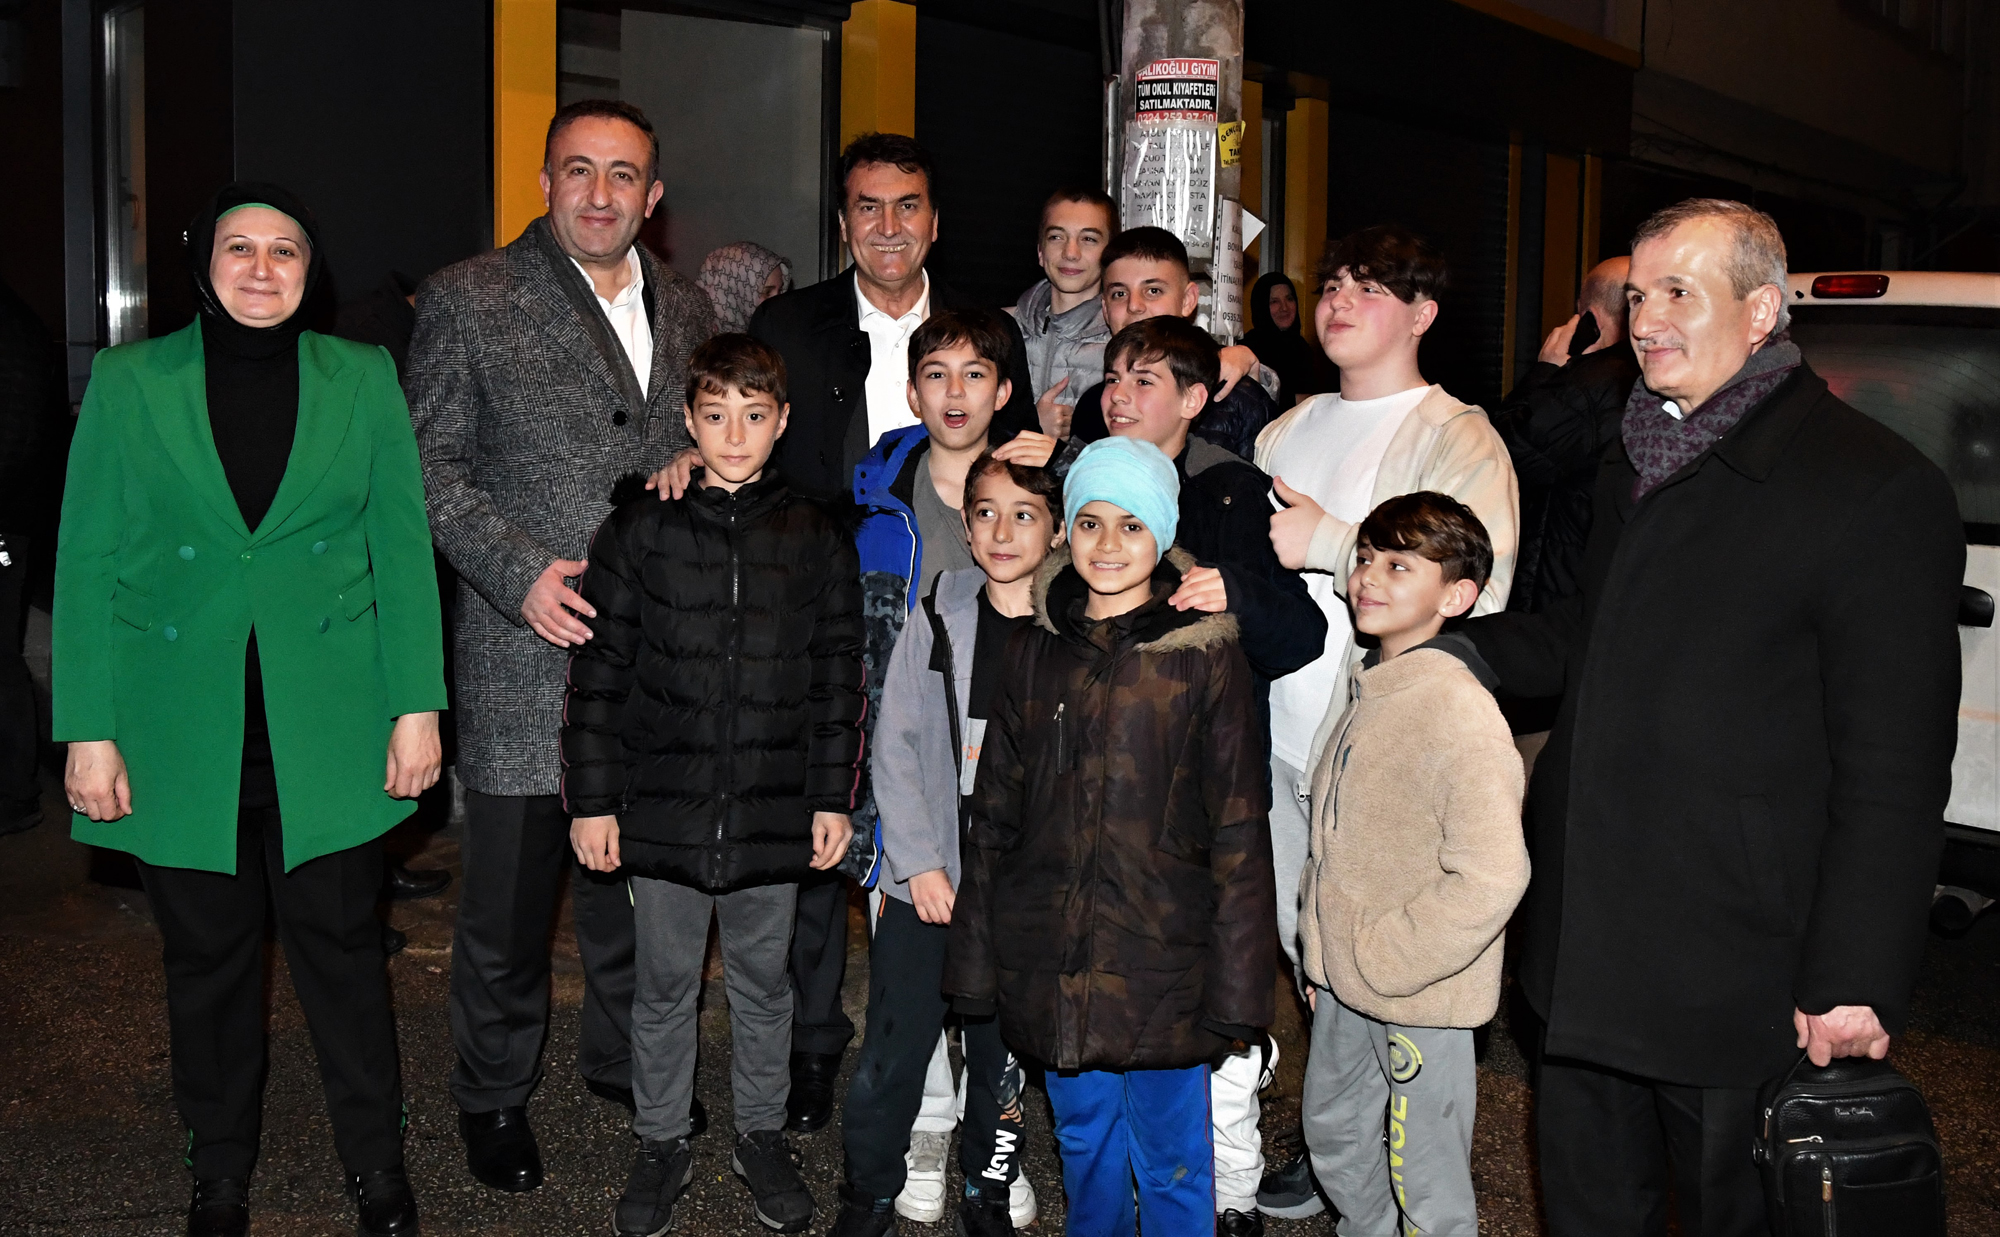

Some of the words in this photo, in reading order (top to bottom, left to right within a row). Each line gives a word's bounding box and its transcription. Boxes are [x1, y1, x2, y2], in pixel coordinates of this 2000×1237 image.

[1138, 82, 1151, 97] TÜM
[1152, 82, 1171, 96] OKUL
[1192, 204, 1204, 212] VE
